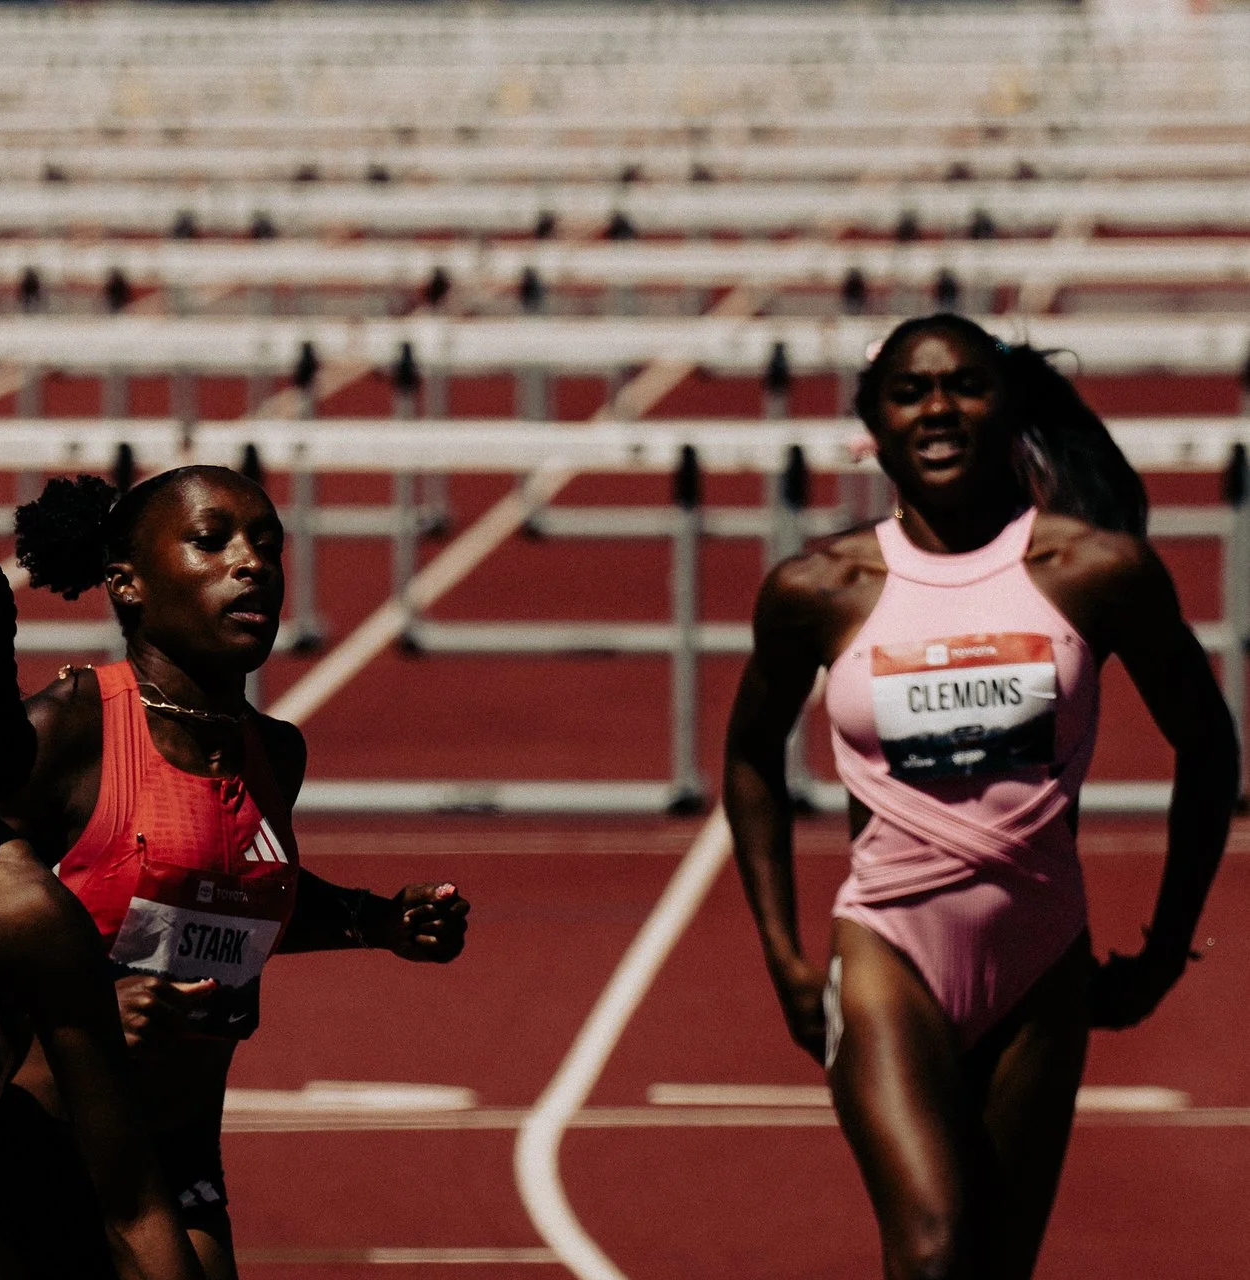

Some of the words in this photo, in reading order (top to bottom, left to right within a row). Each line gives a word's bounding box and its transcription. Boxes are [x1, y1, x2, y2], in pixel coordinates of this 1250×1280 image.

[907, 677, 1023, 713] CLEMONS
[216, 889, 249, 903] TOYOTA
[178, 923, 248, 963] STARK
